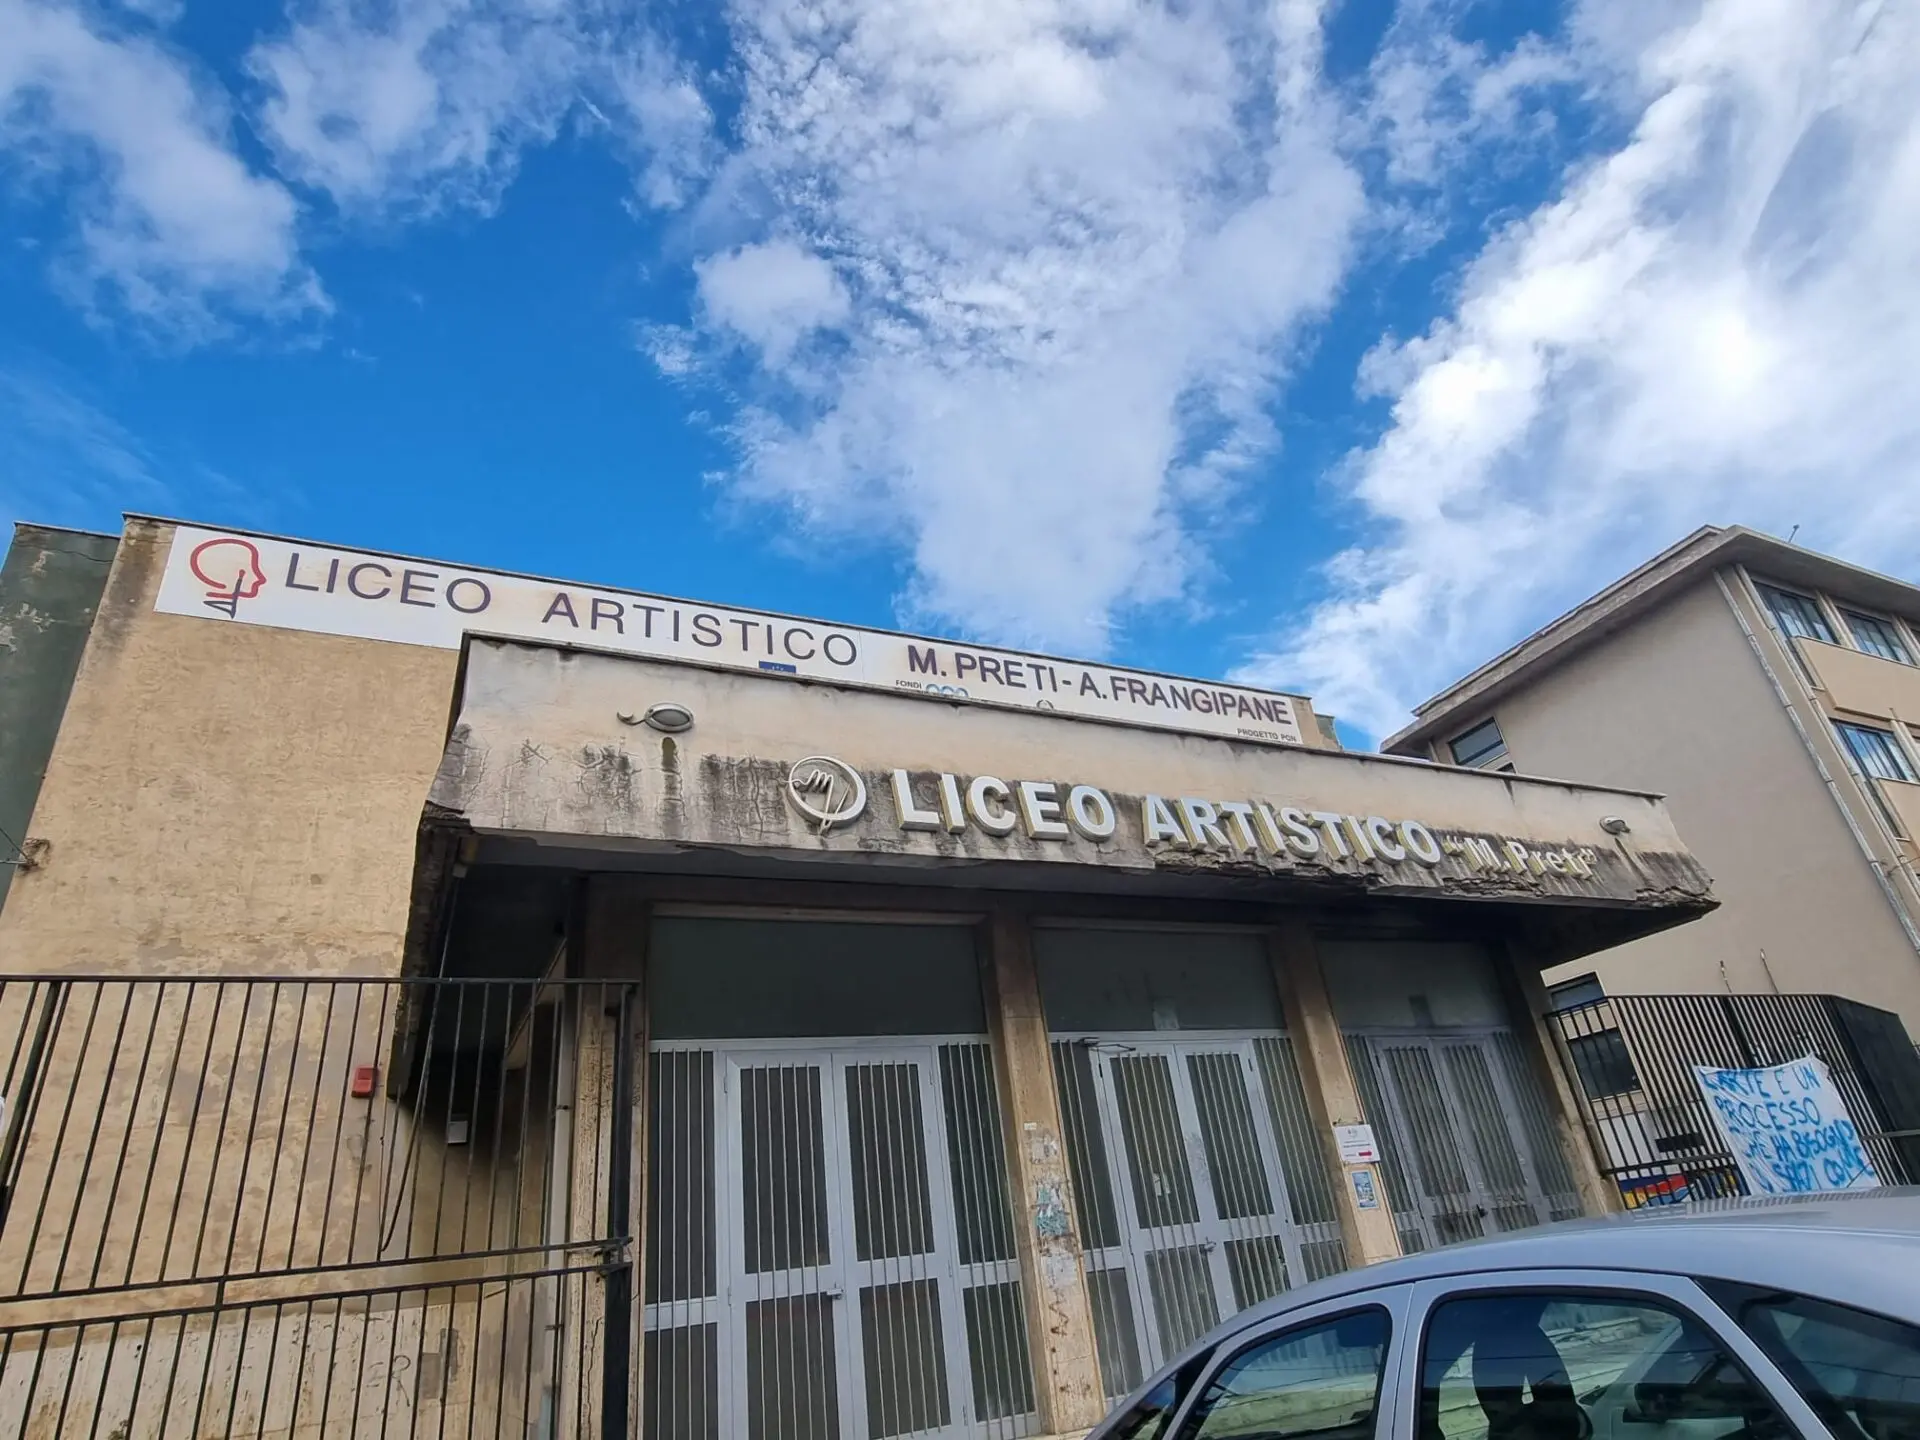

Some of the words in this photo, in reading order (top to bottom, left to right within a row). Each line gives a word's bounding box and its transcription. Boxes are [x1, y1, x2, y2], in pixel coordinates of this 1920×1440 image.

[285, 552, 491, 614] LICEO
[541, 592, 857, 666] ARTISTICO
[895, 679, 922, 690] FONDI
[1237, 728, 1279, 740] PROGETTO
[890, 768, 1117, 842] LICEO
[1142, 794, 1441, 867] ARTISTICO
[1792, 1063, 1821, 1090] UN
[1714, 1096, 1821, 1132] PROCESSO
